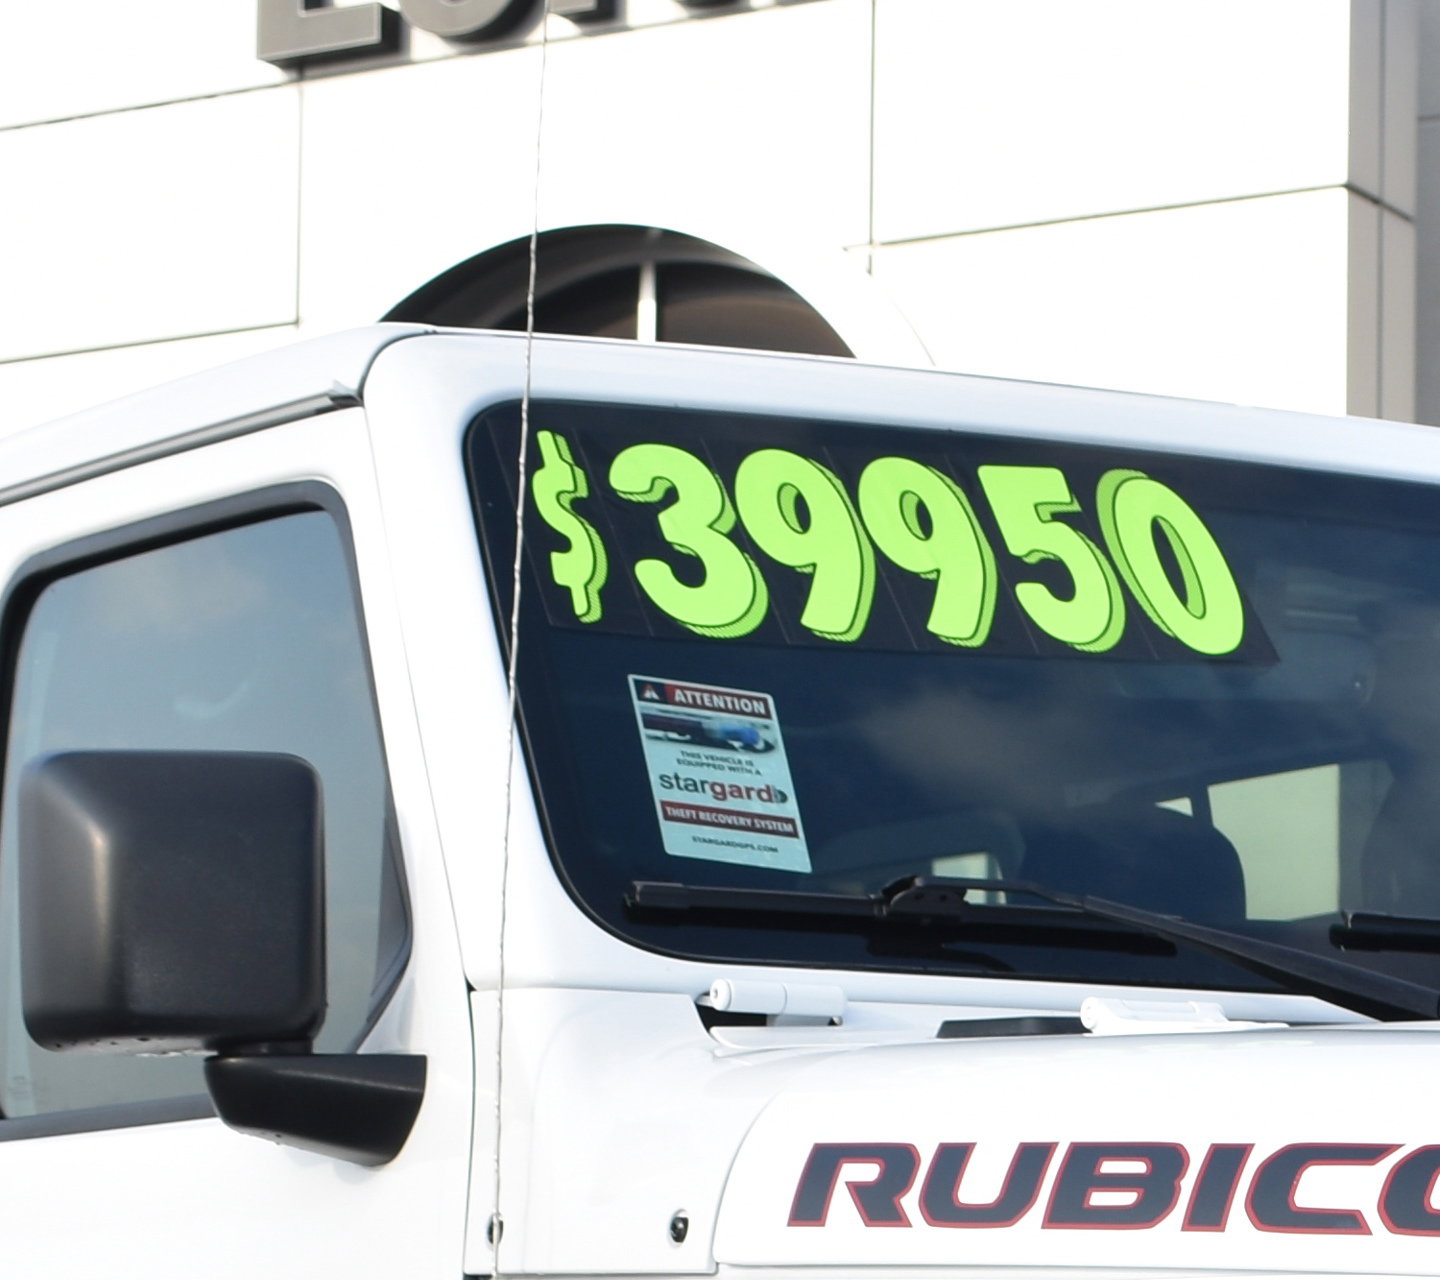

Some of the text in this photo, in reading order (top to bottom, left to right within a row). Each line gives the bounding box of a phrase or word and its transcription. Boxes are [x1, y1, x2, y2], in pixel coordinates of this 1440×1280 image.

[532, 429, 1245, 656] $39950
[673, 688, 766, 715] ATTENTION
[676, 758, 725, 771] EQUIPPED
[727, 765, 753, 775] WITH
[680, 750, 702, 760] THIS
[704, 754, 743, 765] VEHICLE
[658, 772, 775, 804] stargard
[665, 806, 794, 833] THEFT RECOVERY SYSTEM
